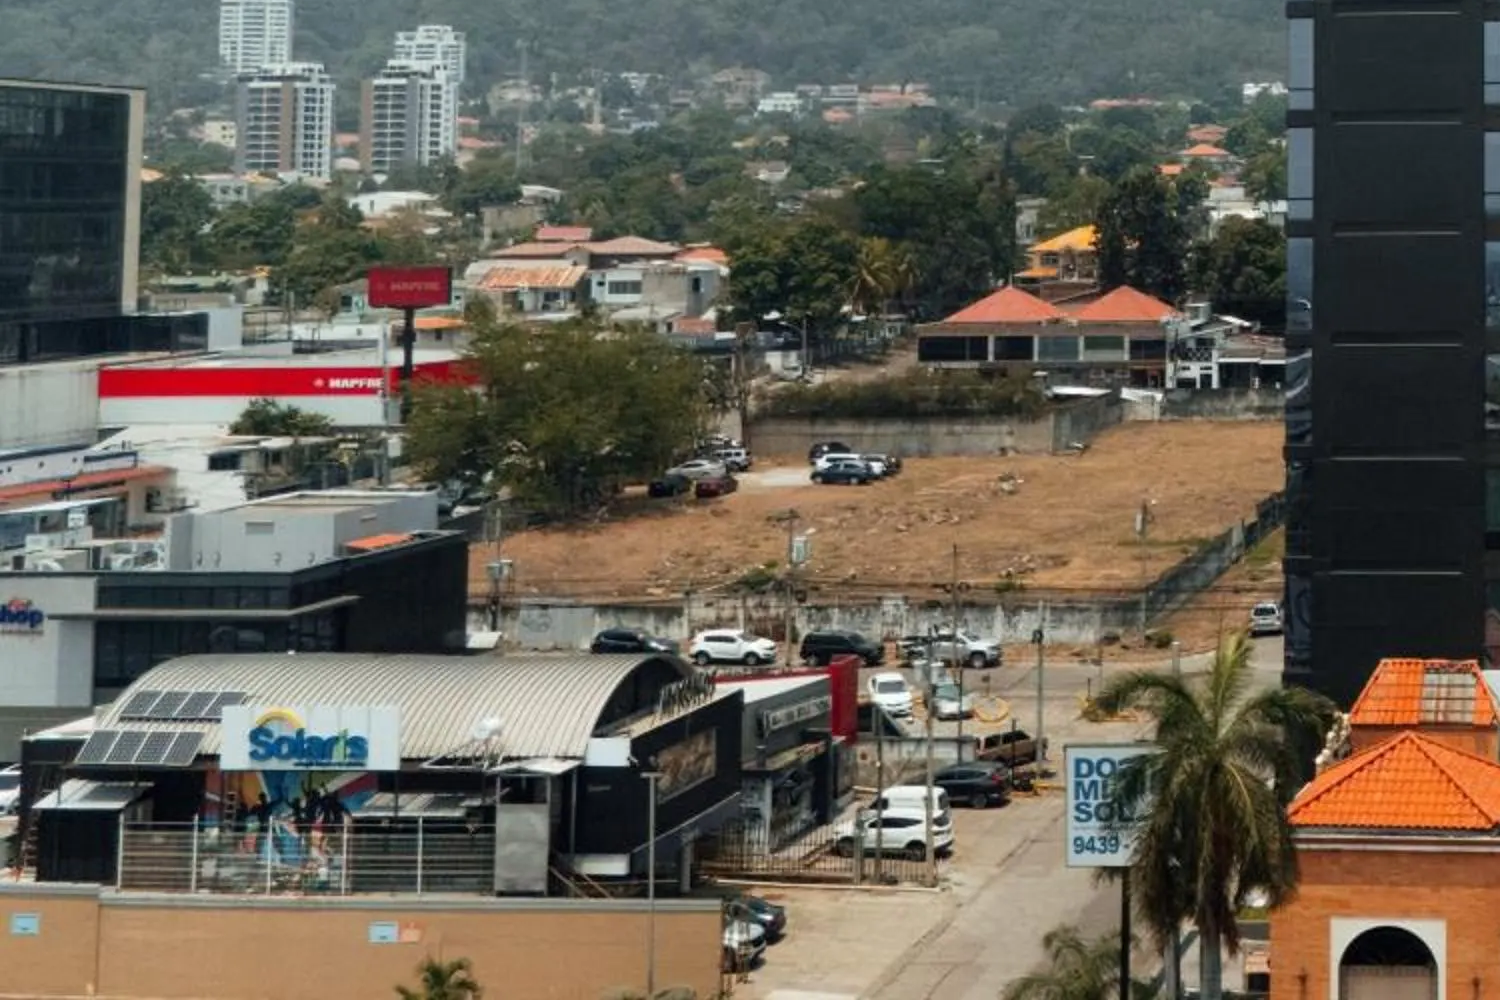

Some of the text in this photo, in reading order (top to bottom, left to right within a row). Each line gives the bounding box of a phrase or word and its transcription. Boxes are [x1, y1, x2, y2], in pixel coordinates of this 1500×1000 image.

[329, 377, 384, 389] MAPFRE
[0, 604, 44, 629] hop
[249, 726, 368, 761] Solaris
[1074, 757, 1117, 778] DO
[1073, 835, 1120, 854] 9439
